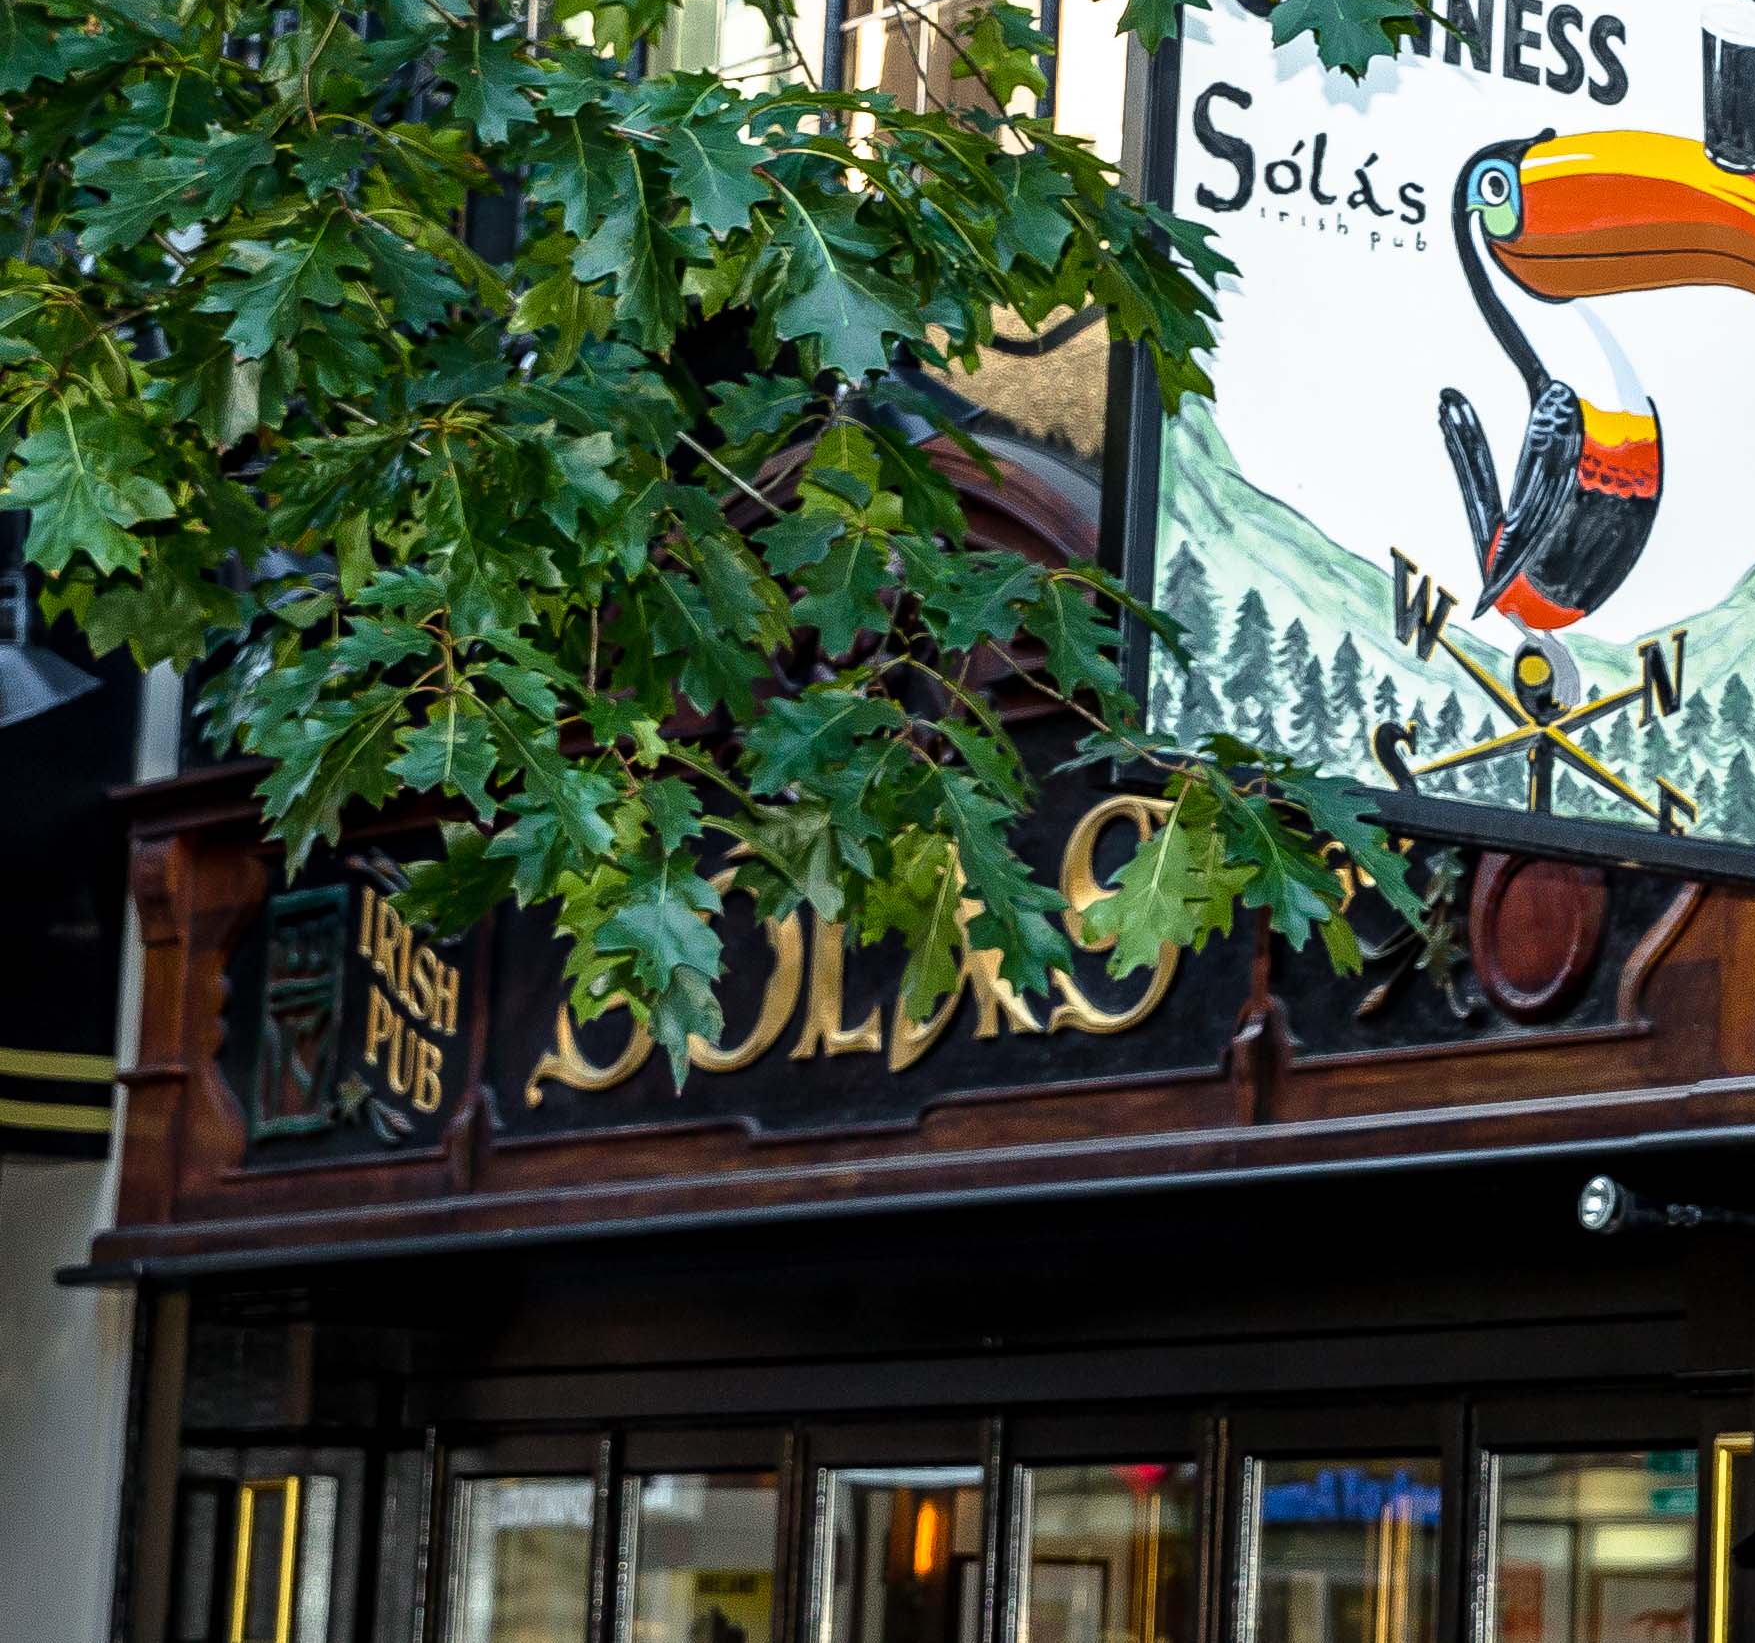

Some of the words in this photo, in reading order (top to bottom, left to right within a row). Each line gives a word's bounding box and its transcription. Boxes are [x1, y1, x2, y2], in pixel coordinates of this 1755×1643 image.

[1192, 80, 1427, 226] Sólás
[1260, 207, 1349, 235] irish
[1370, 231, 1428, 252] pub
[1637, 629, 1688, 728] N
[357, 884, 461, 1036] IRISH
[363, 983, 444, 1114] PUB
